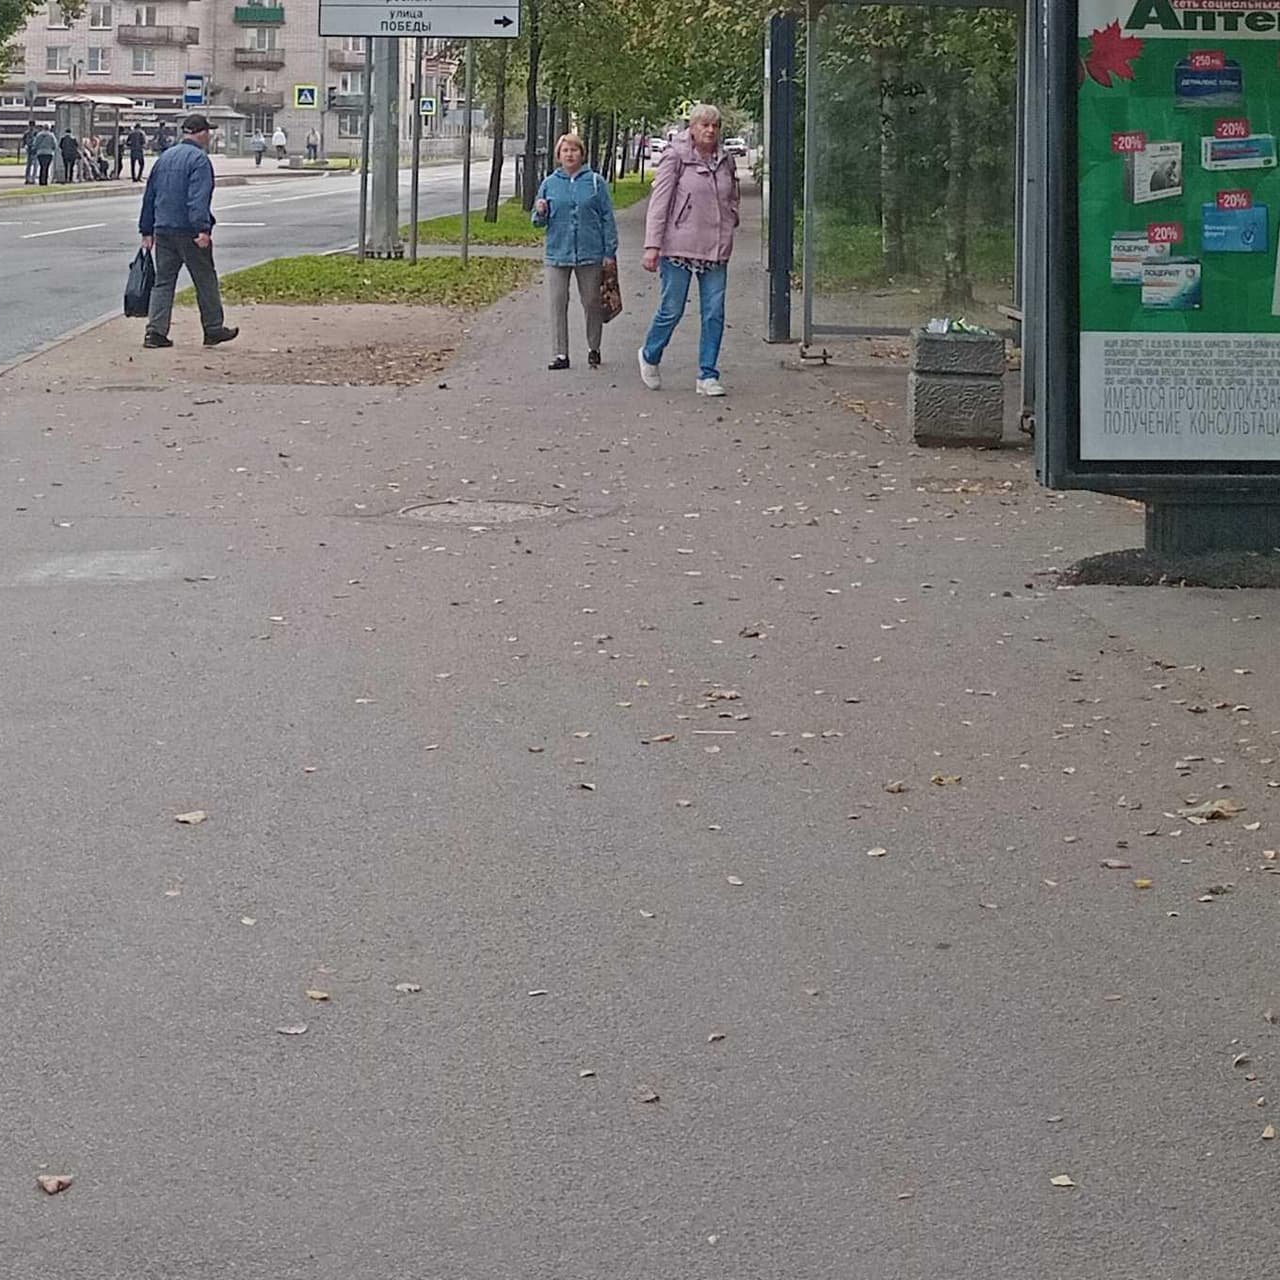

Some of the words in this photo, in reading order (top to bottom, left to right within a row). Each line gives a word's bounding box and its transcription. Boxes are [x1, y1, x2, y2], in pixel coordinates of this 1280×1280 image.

[1173, 0, 1199, 10] сеть
[1202, 0, 1280, 11] социальных
[389, 10, 423, 19] улица
[380, 21, 431, 33] ПОБЕДЫ
[1216, 122, 1245, 136] -20%
[1113, 136, 1142, 150] -20%
[1219, 194, 1247, 208] -20%
[1150, 227, 1178, 241] -20%
[1104, 386, 1166, 410] ИМЕЮТСЯ
[1104, 411, 1180, 435] ПОЛУЧЕНИЕ
